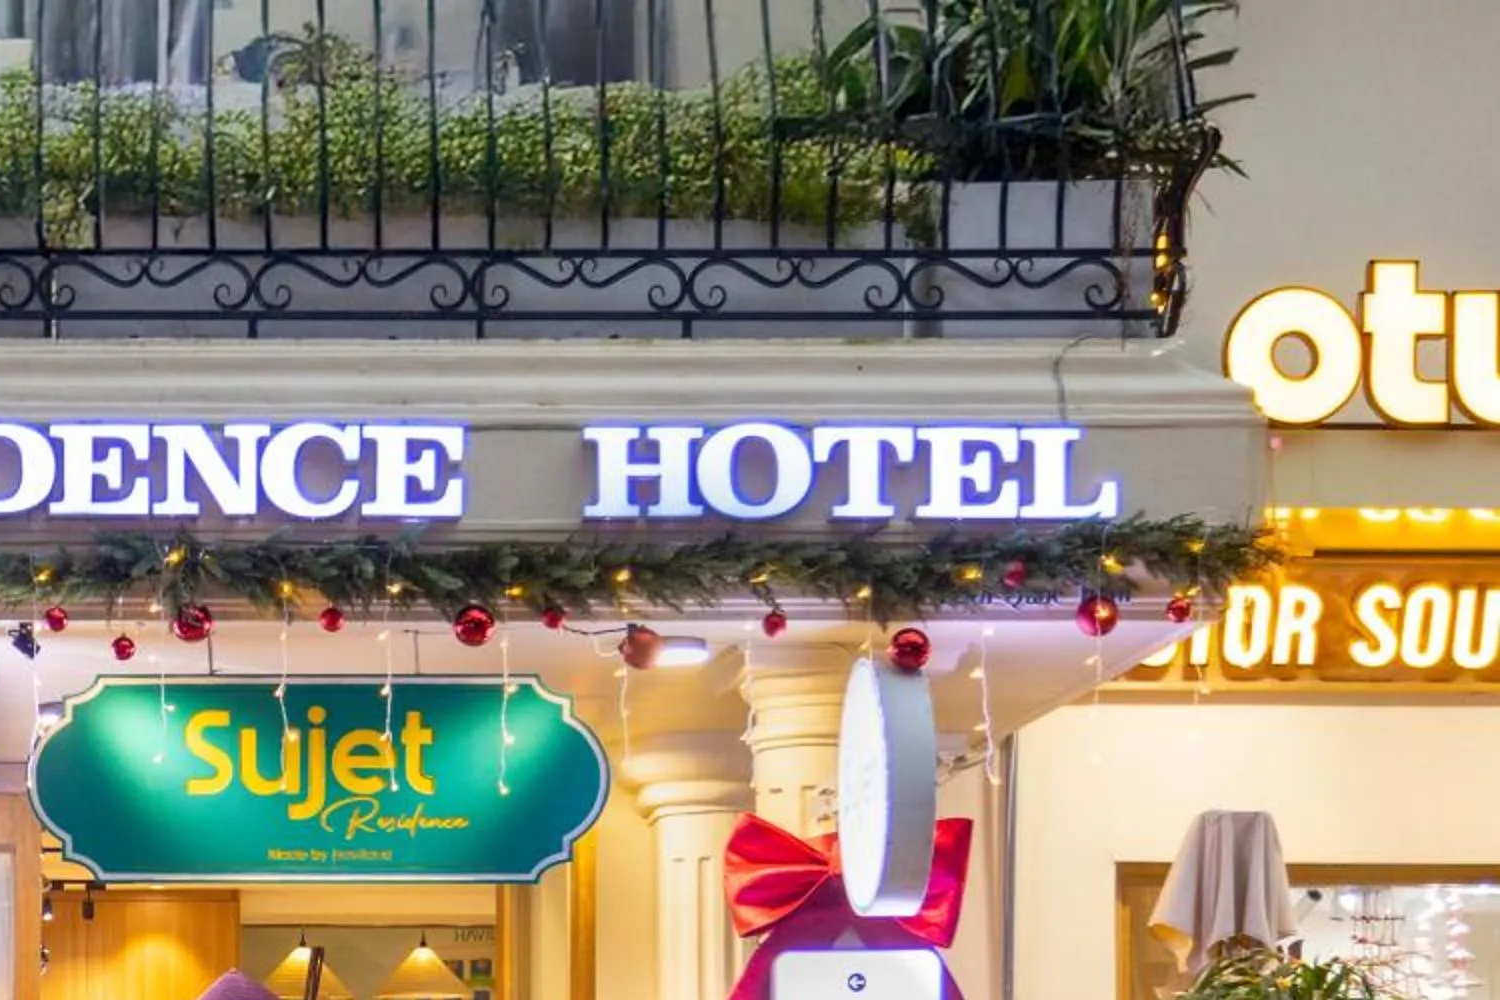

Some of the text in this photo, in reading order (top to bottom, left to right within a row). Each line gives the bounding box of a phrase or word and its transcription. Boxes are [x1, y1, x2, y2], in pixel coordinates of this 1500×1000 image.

[582, 422, 1119, 520] HOTEL
[184, 705, 436, 820] Sujet
[320, 796, 469, 840] Residence
